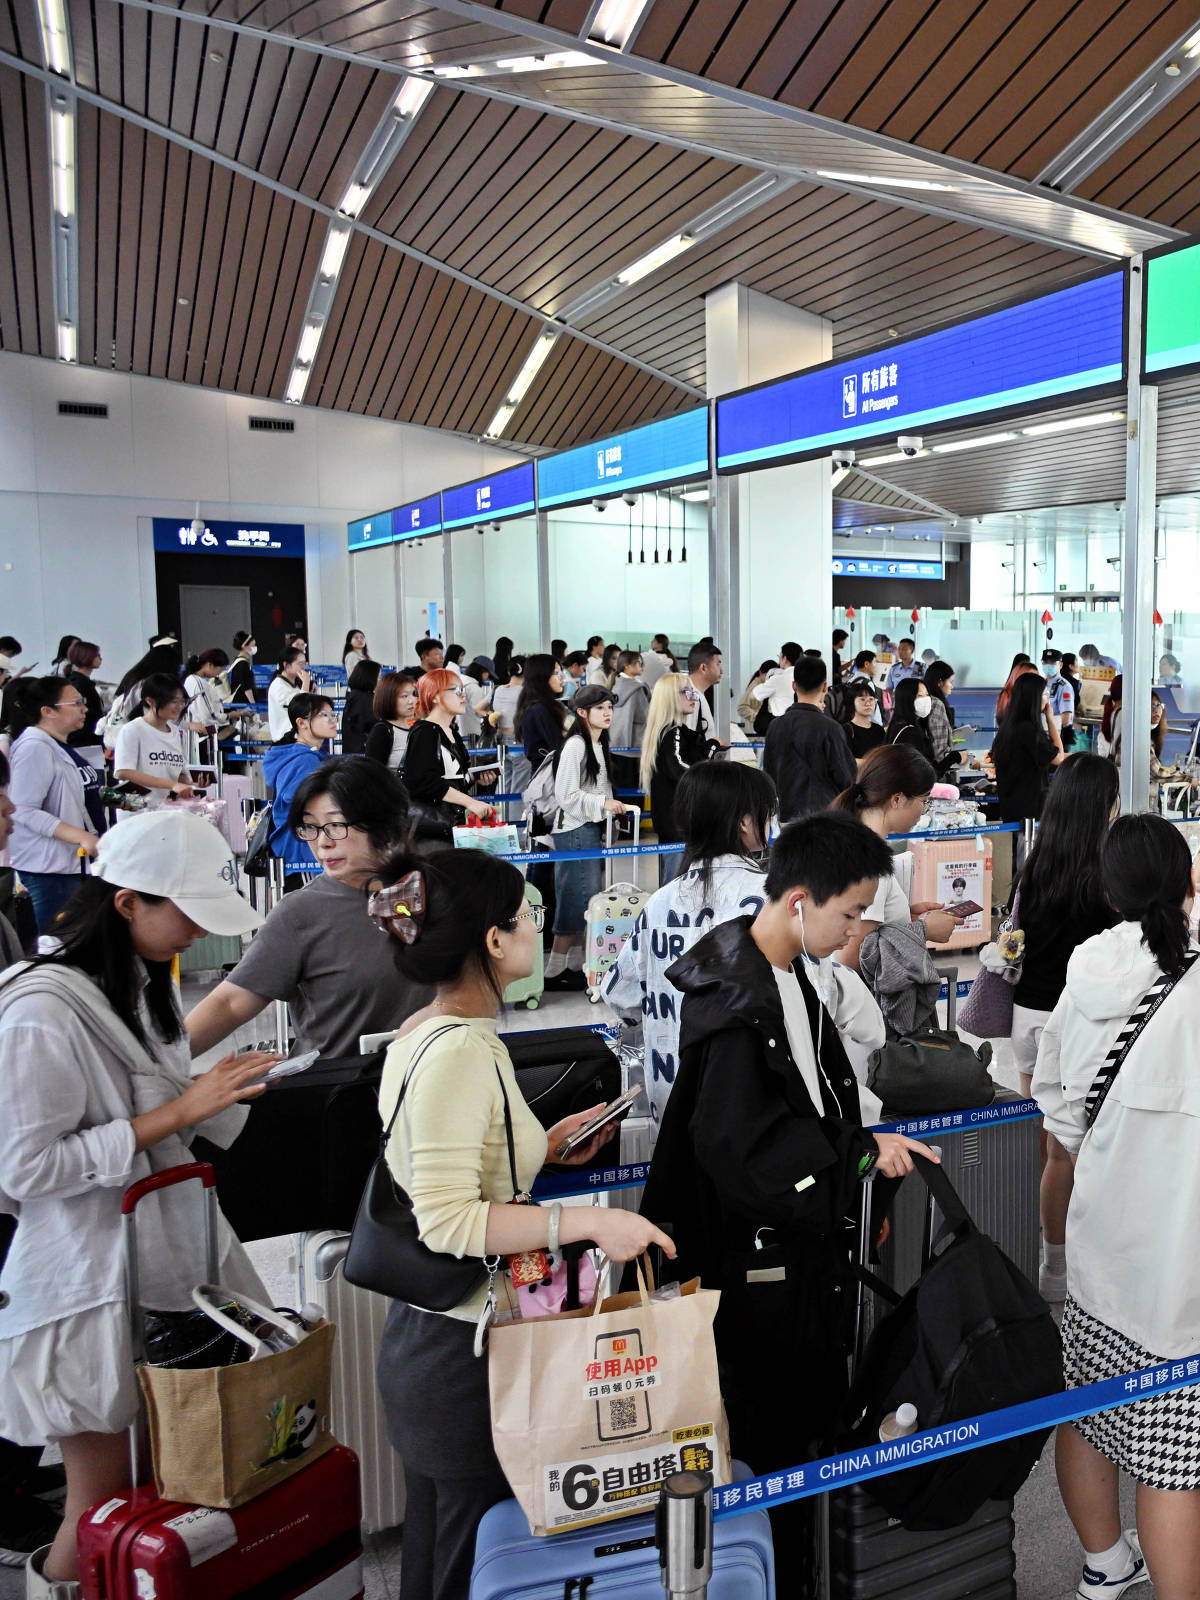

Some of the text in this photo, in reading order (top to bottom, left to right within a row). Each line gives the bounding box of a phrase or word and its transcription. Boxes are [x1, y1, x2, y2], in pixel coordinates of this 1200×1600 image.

[149, 750, 184, 763] adidas
[896, 1114, 963, 1135] 中国移民管理
[970, 1108, 999, 1122] CHINA
[589, 1165, 650, 1185] 中国移民
[586, 1355, 658, 1382] 使用App
[588, 1375, 657, 1398] 扫码领0元券
[819, 1454, 871, 1479] CHINA
[875, 1422, 980, 1465] IMMIGRATION
[548, 1469, 561, 1492] 我的
[602, 1453, 678, 1491] 自由搭
[561, 1463, 601, 1512] 6
